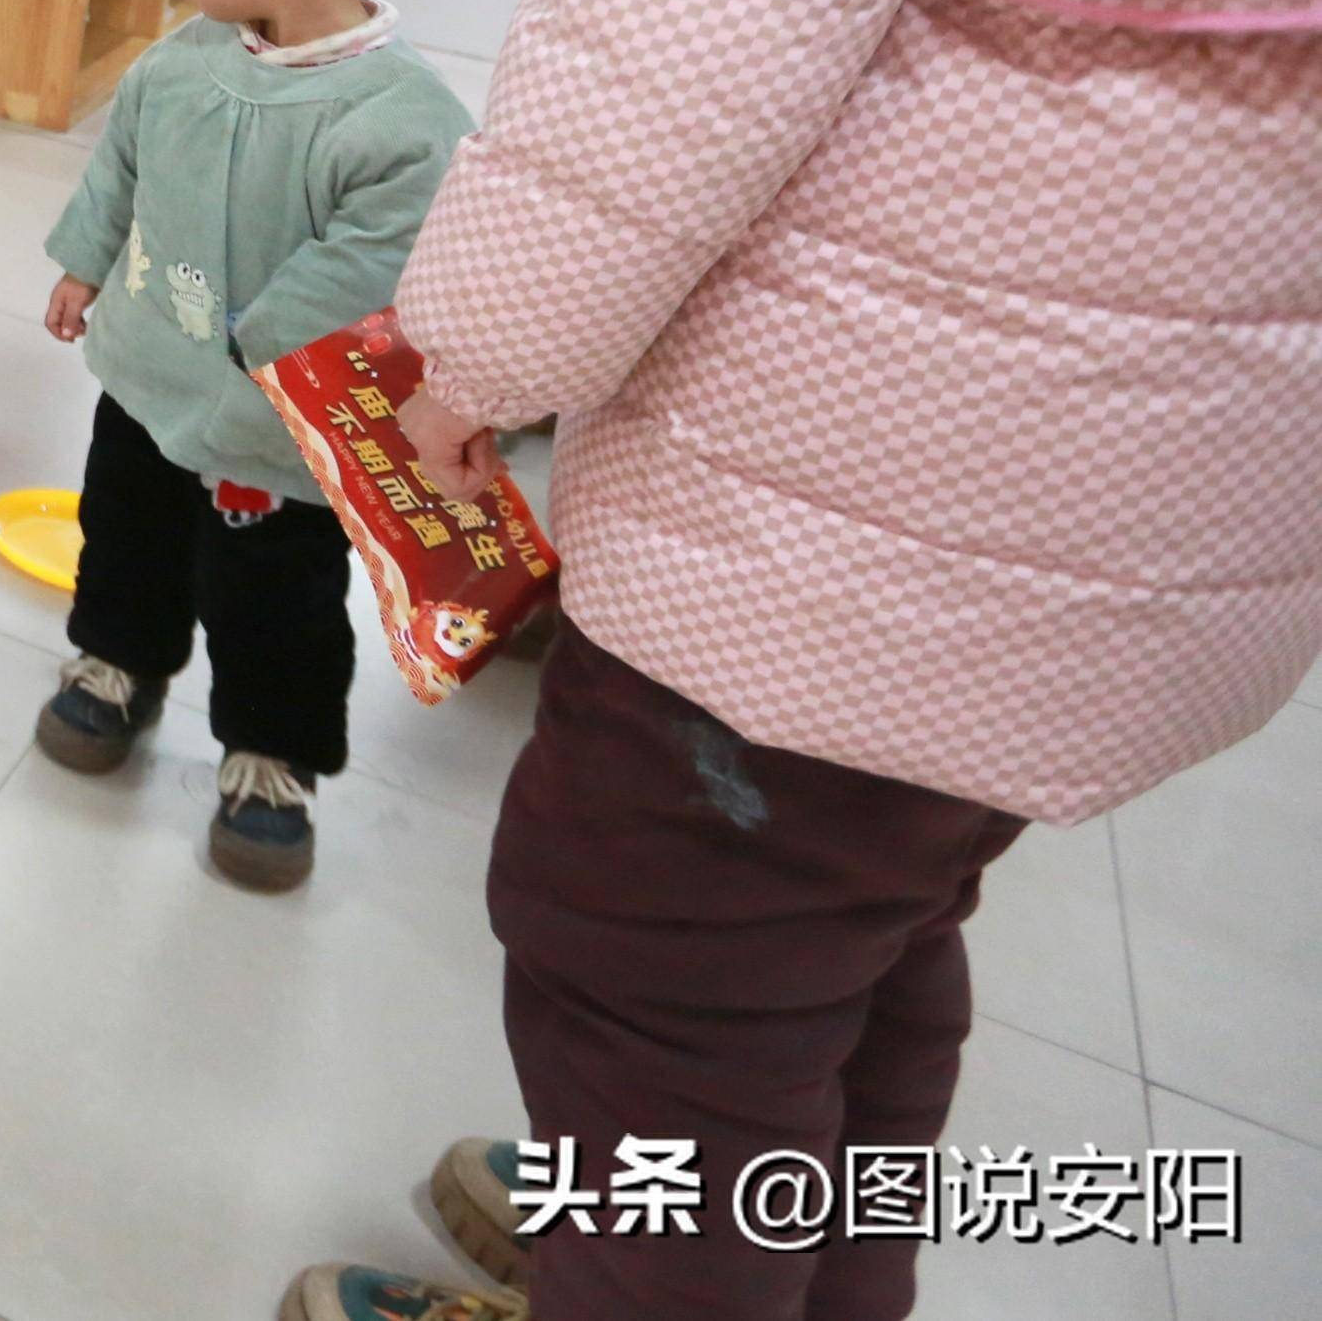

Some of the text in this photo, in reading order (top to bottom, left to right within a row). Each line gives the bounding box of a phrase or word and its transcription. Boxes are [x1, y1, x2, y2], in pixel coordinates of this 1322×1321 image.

[325, 400, 452, 551] 不期而遇
[327, 431, 403, 541] HAPPY NEW YEAR
